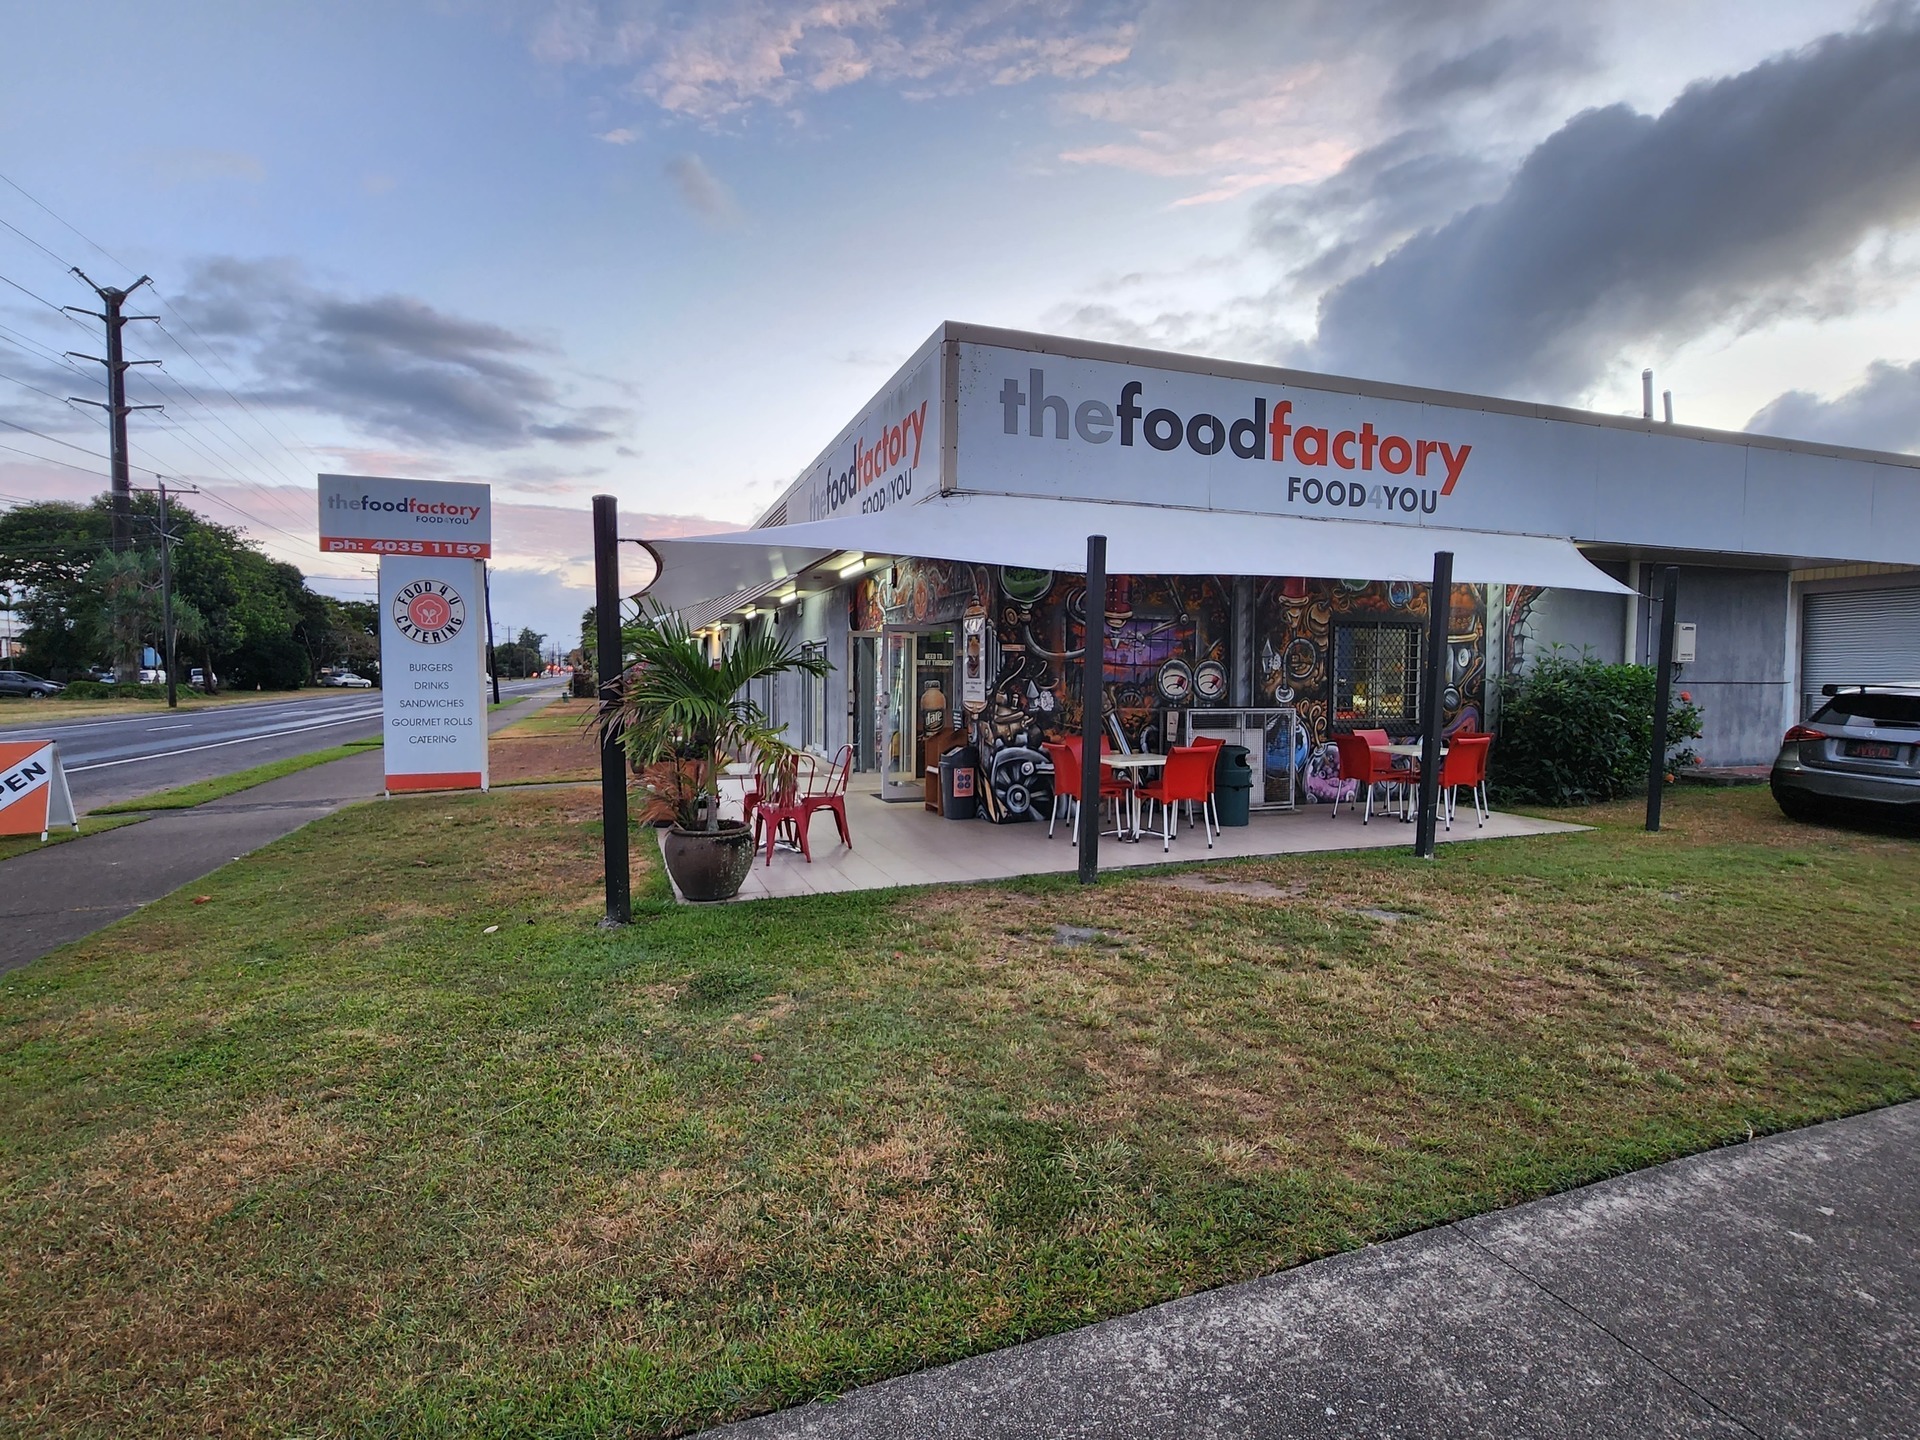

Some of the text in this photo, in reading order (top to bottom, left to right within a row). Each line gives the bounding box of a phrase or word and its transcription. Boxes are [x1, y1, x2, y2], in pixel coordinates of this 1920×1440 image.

[1287, 476, 1438, 514] FOOD4YOU
[415, 515, 469, 525] FOOD4YOU
[329, 539, 481, 555] ph: 4035 1159
[397, 581, 461, 605] FOOD 4 U
[396, 615, 462, 643] CATERING
[409, 663, 454, 672] BURGERS
[414, 681, 450, 690] DRINKS
[399, 699, 465, 708] SANDWICHES
[391, 717, 473, 727] GOURMET ROLLS
[925, 711, 943, 726] dare
[408, 735, 457, 744] CATERING
